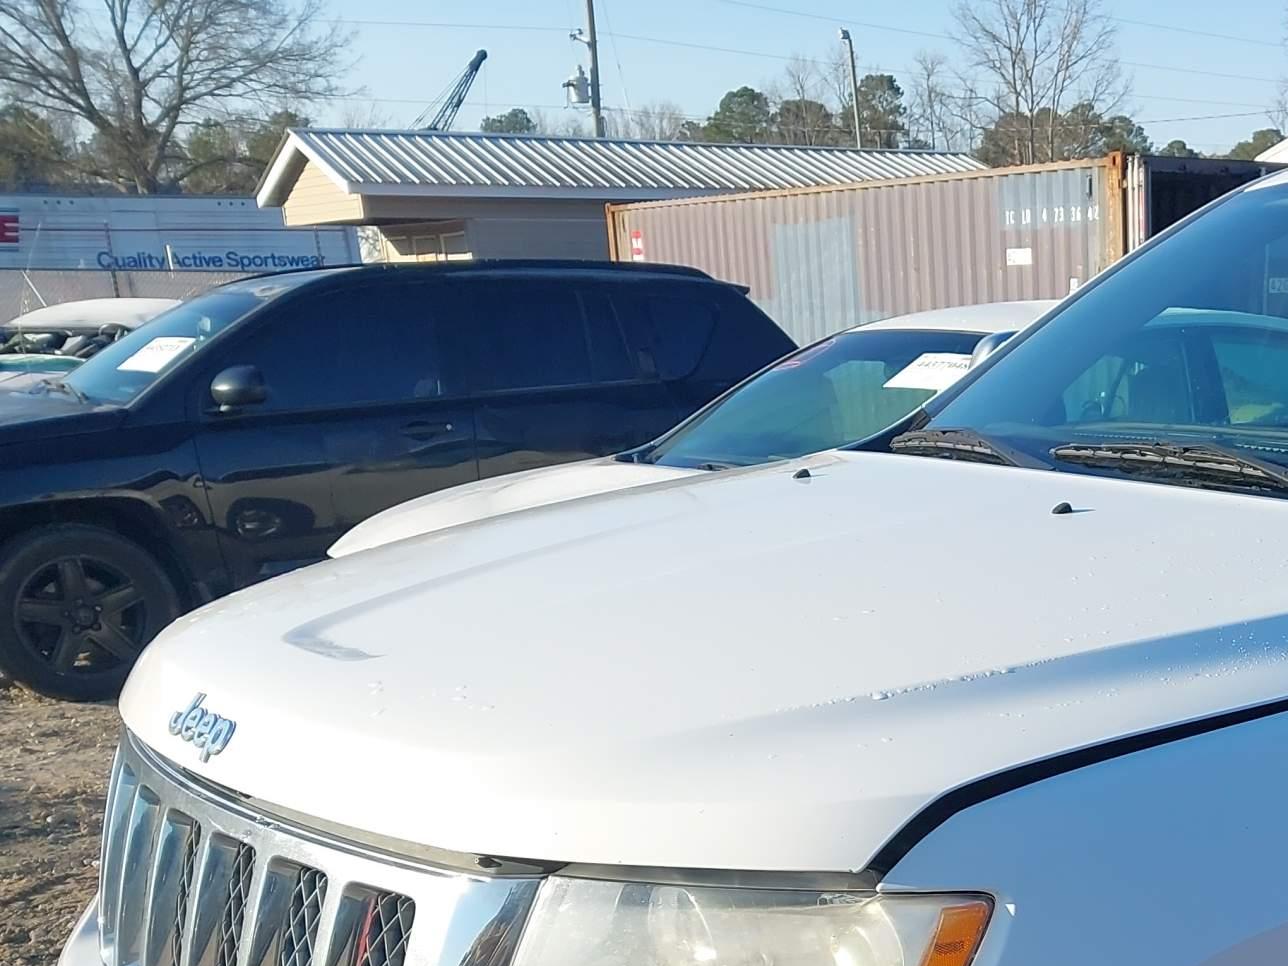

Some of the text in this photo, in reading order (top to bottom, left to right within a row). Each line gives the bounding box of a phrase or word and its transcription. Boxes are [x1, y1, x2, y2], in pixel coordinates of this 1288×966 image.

[96, 251, 326, 271] Quality Active Sportswear
[168, 691, 236, 763] Jeep
